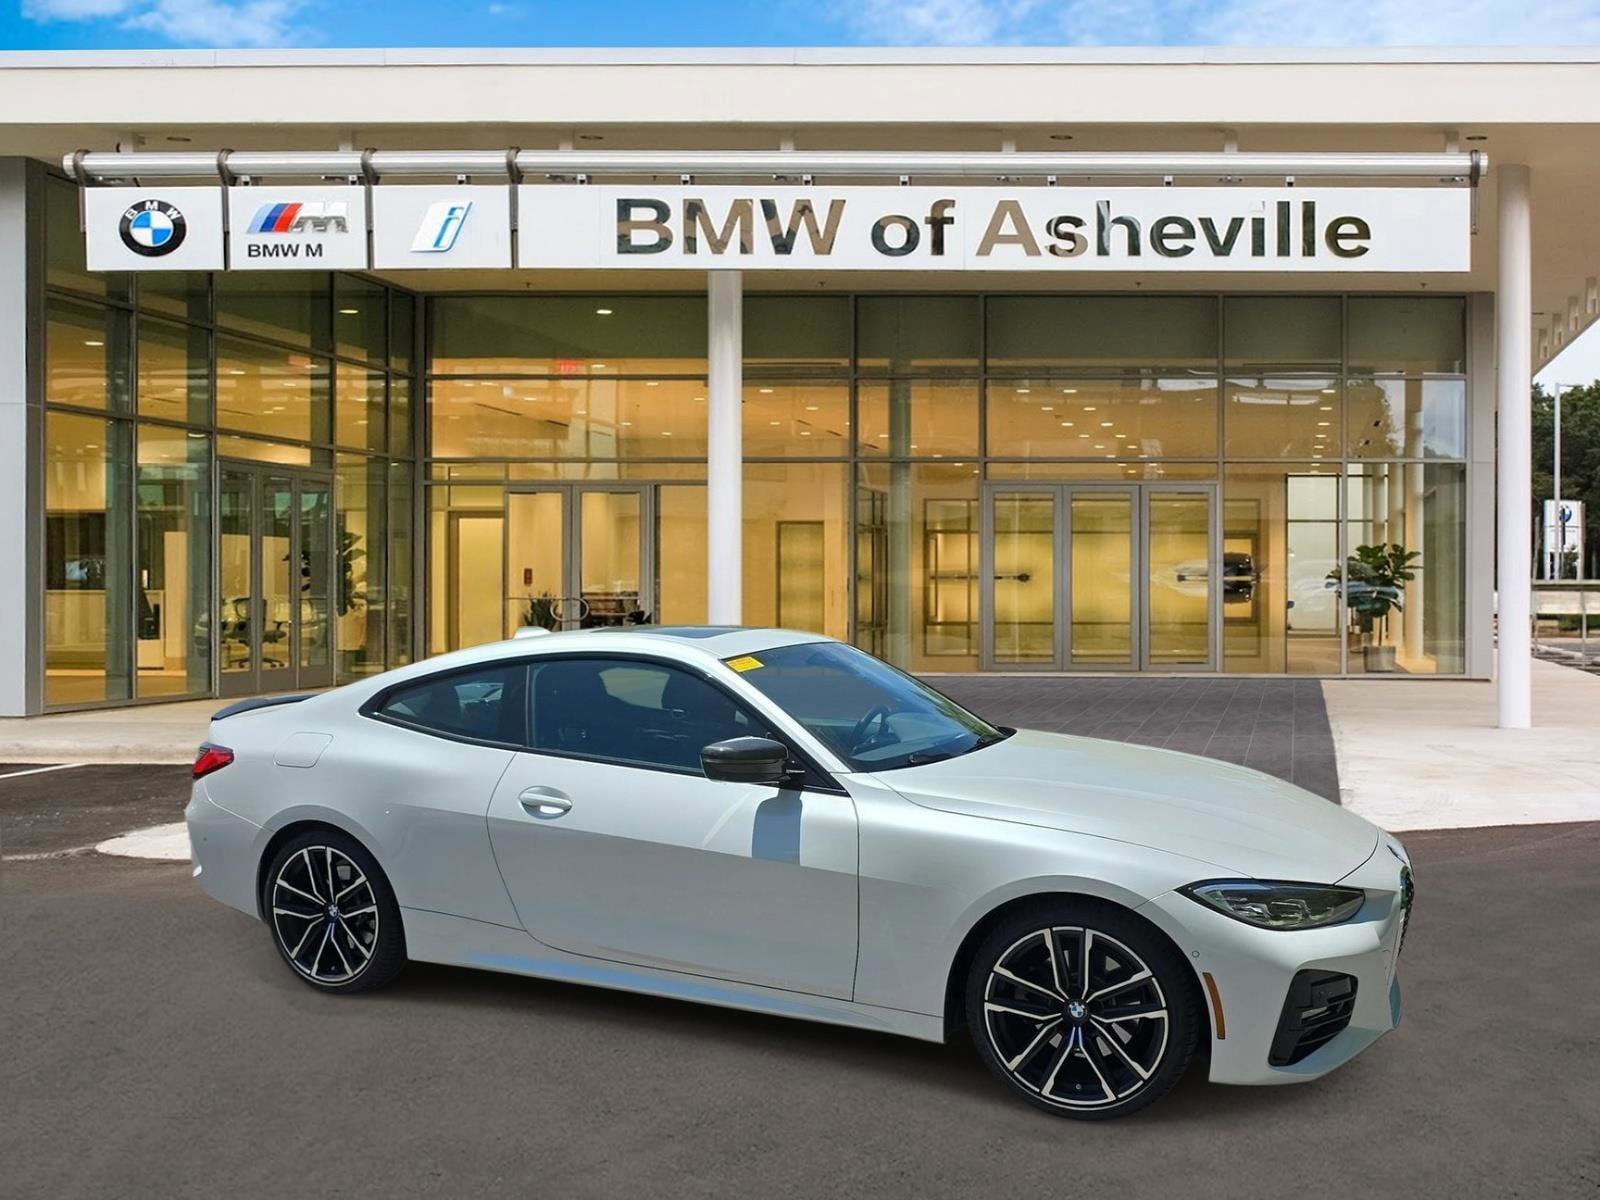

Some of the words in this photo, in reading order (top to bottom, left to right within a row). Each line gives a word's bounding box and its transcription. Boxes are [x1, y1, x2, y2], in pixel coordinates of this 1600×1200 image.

[125, 200, 181, 220] BMW
[616, 198, 846, 255] BMW
[871, 199, 956, 257] of
[975, 199, 1372, 258] Asheville
[247, 243, 300, 258] BMW
[305, 243, 323, 258] M
